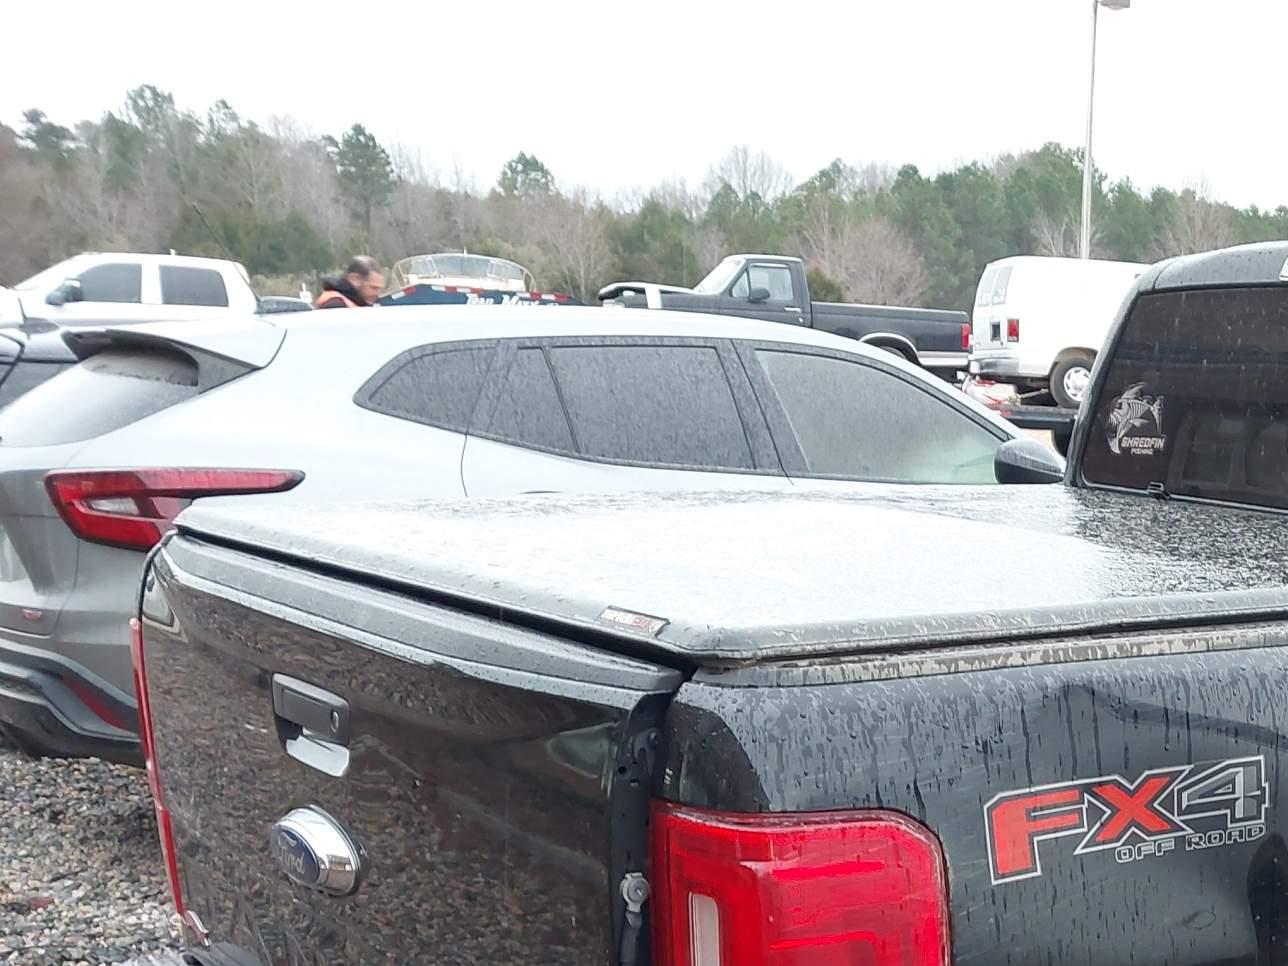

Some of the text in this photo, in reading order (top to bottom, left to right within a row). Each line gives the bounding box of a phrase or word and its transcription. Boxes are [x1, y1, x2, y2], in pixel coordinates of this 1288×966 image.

[1121, 436, 1165, 448] SHREDFIN
[983, 755, 1270, 885] FX4
[278, 832, 305, 875] Ford
[1115, 822, 1267, 864] OFF ROAD
